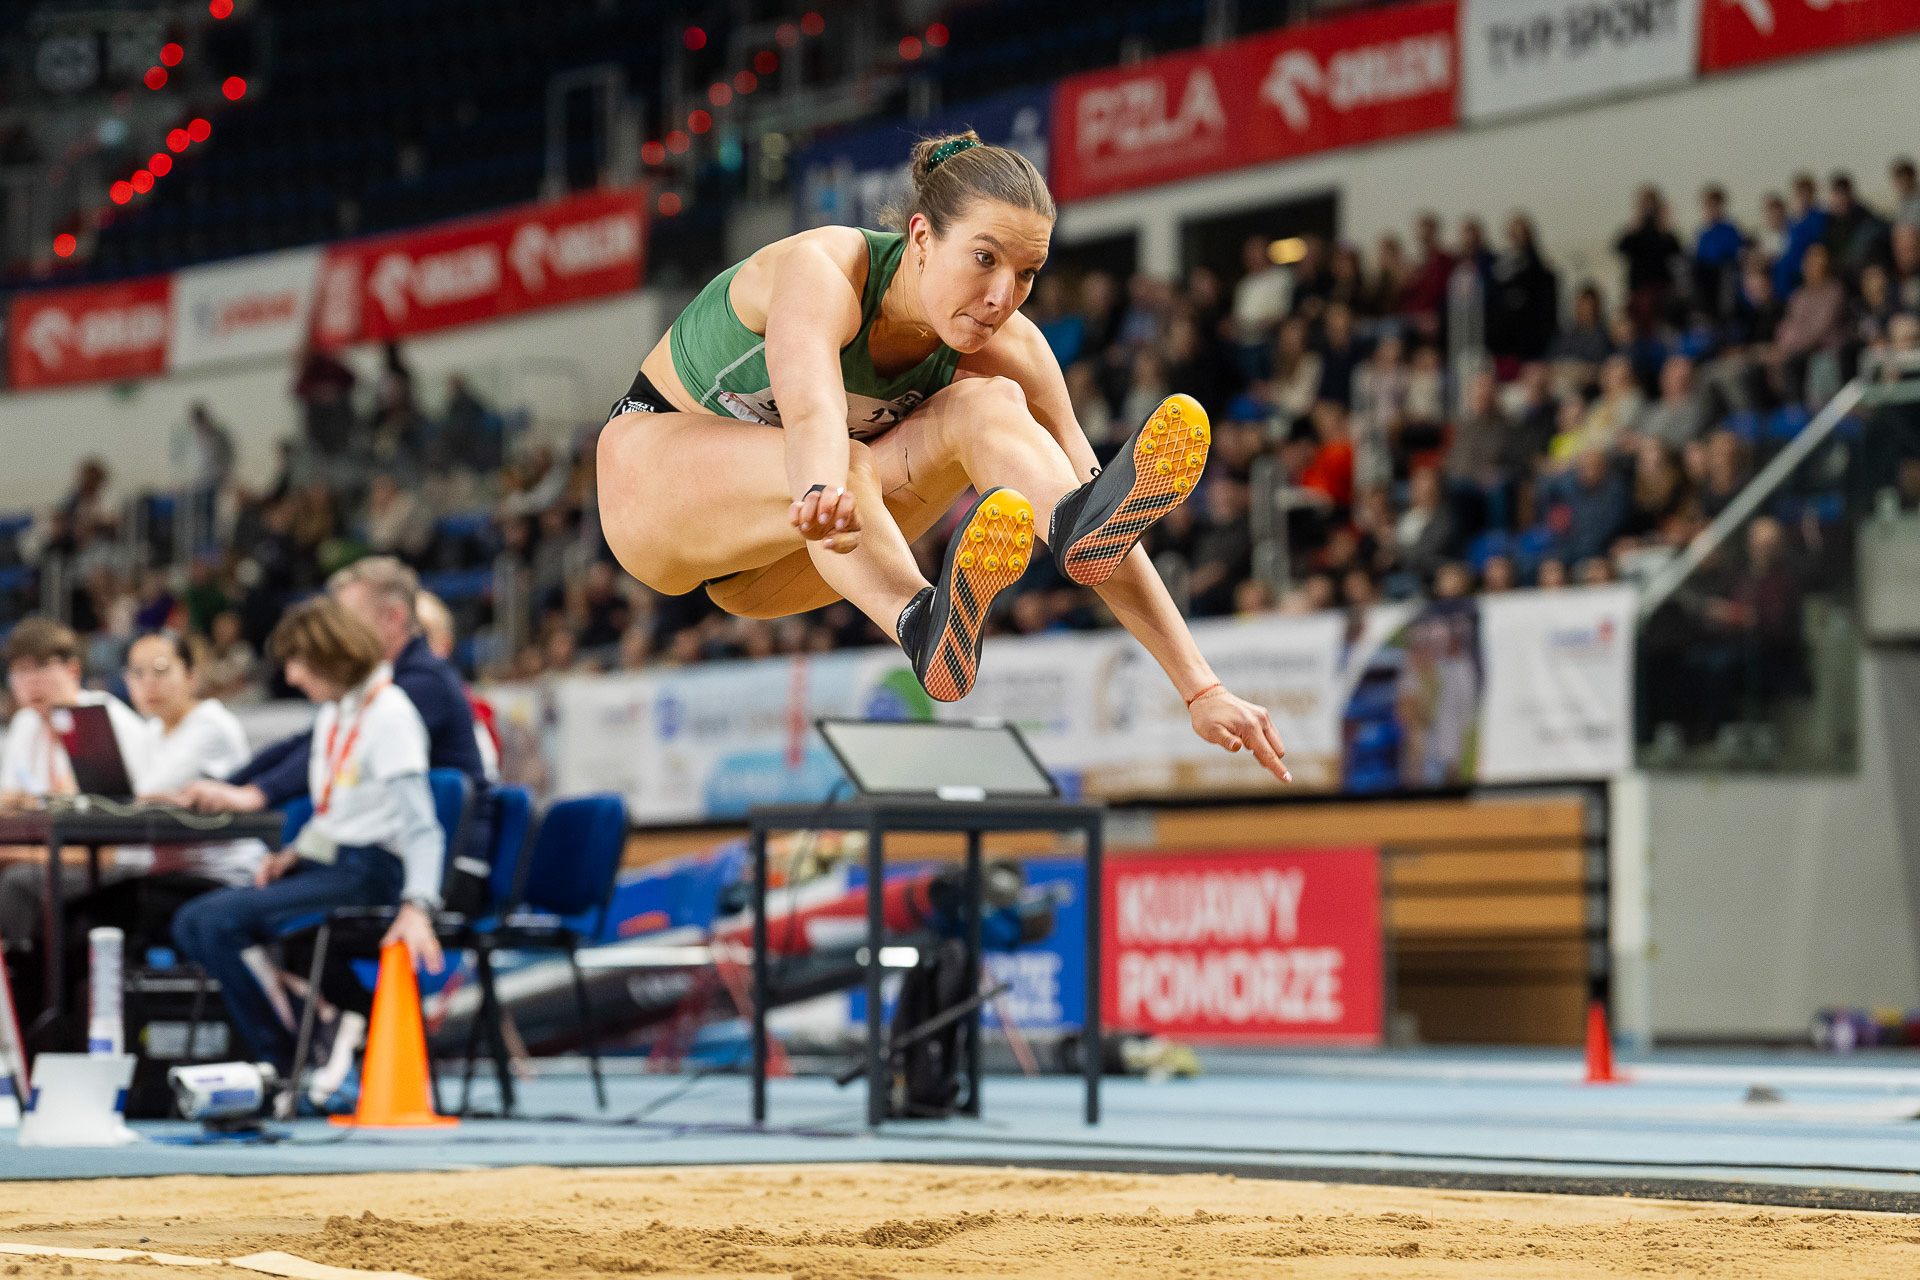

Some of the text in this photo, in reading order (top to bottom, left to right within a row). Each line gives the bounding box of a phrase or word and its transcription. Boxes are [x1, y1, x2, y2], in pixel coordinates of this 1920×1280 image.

[1328, 35, 1452, 109] ORLEN
[1116, 868, 1304, 943] KUJAWY
[1118, 948, 1343, 1023] POMORZE
